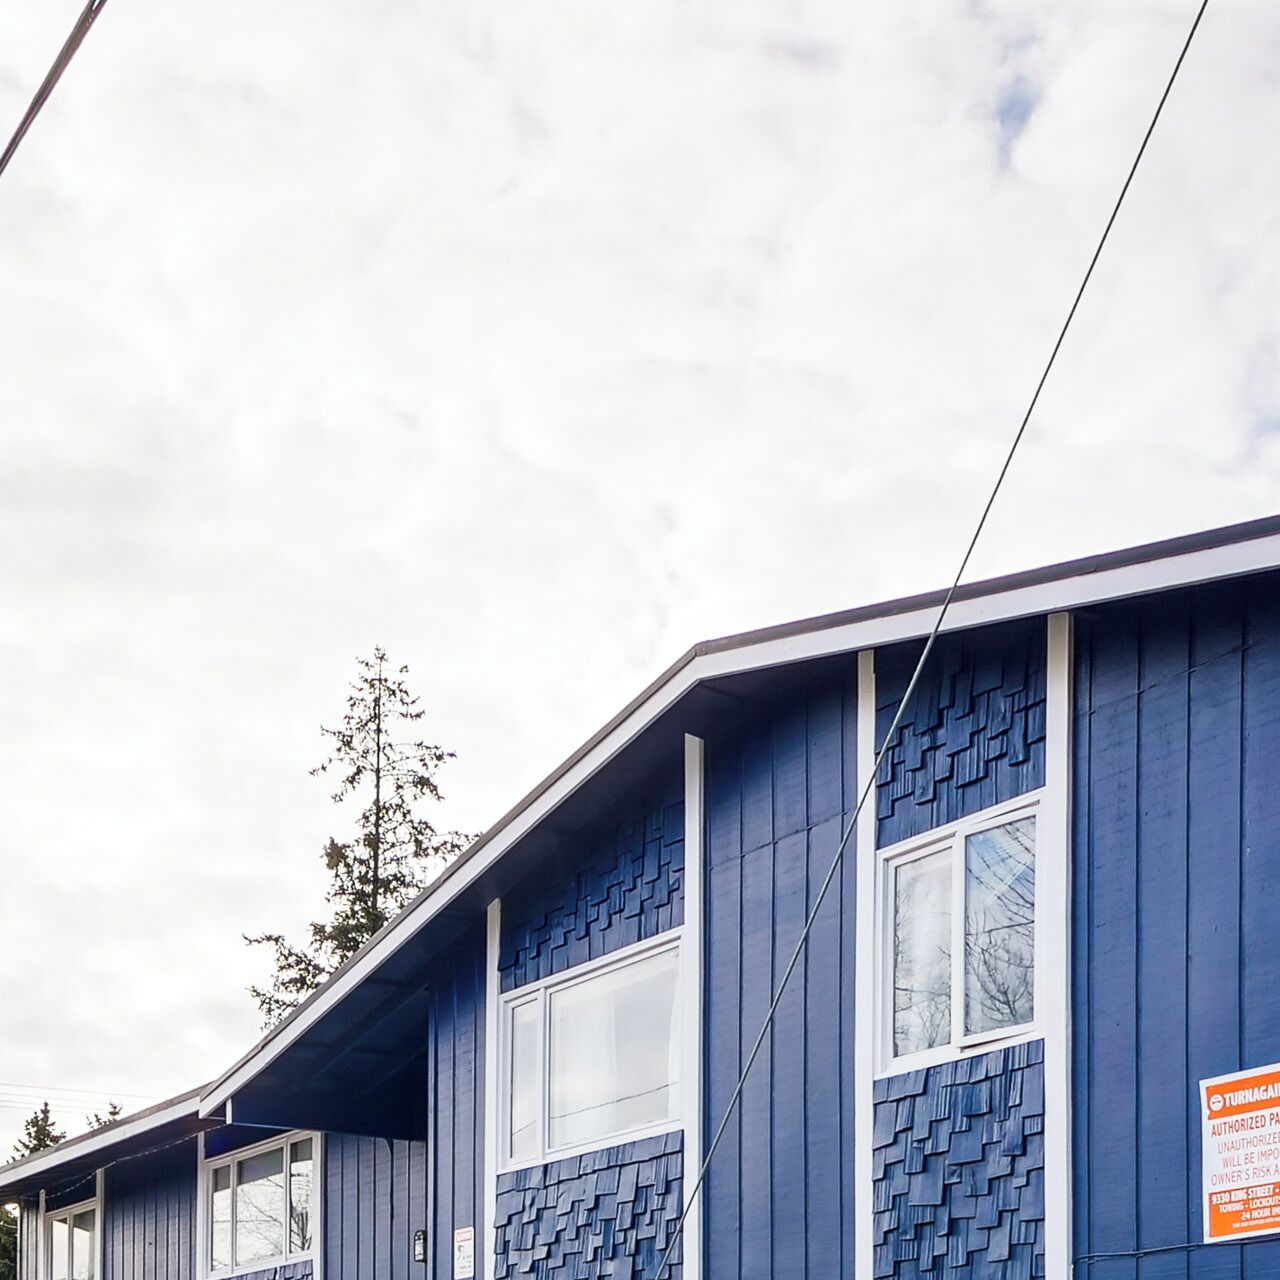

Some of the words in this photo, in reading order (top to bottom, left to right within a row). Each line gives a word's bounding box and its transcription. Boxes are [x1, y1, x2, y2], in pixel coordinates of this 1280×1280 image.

[1211, 1113, 1266, 1137] AUTHORIZED
[1222, 1156, 1242, 1168] WILL
[1244, 1152, 1255, 1165] BE
[1211, 1168, 1250, 1186] OWNER'S
[1252, 1165, 1273, 1179] RISK
[1247, 1184, 1275, 1199] STREET
[1240, 1210, 1250, 1221] 24
